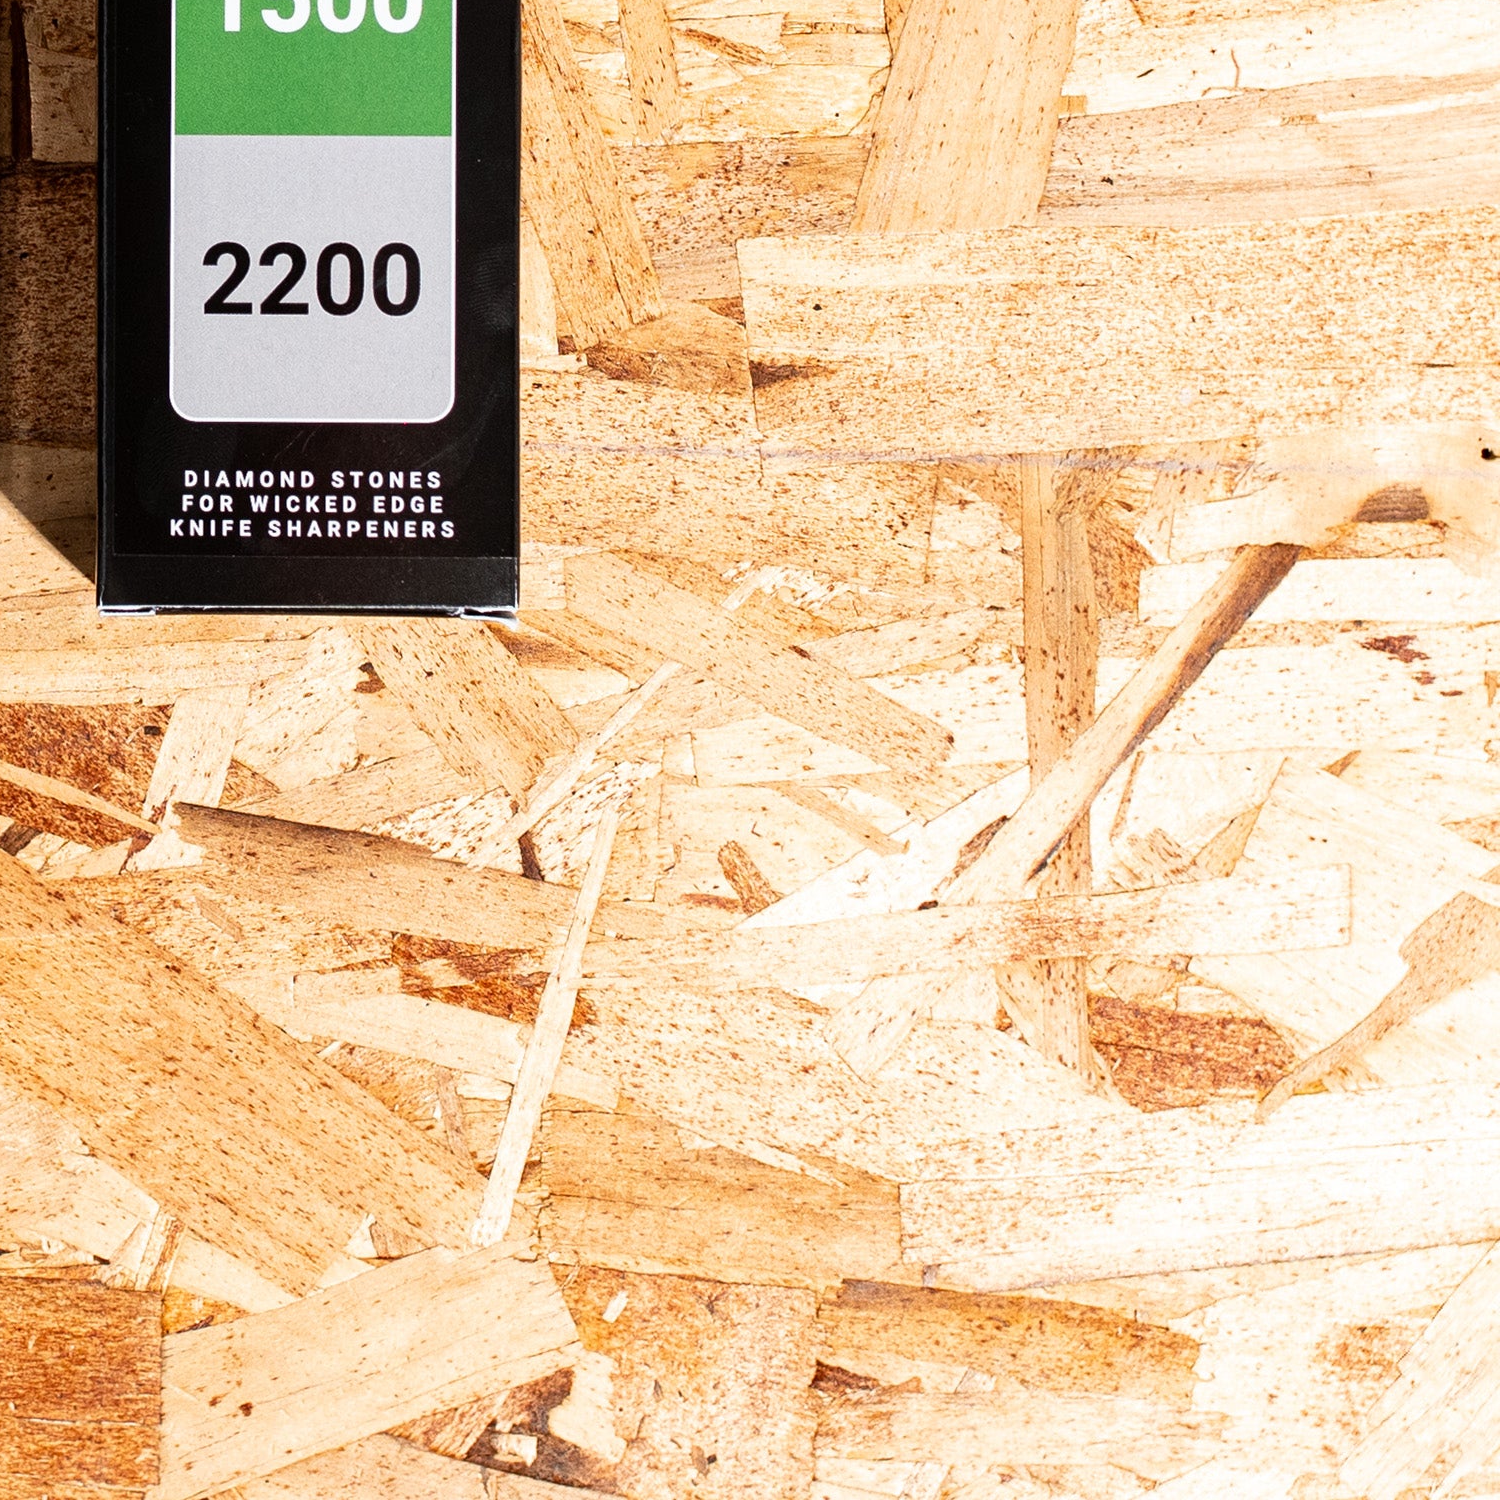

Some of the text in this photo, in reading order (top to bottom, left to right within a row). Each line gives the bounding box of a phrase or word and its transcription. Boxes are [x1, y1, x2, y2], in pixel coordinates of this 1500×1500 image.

[202, 241, 421, 317] 2200
[184, 469, 442, 490] DIAMOND STONES
[181, 494, 445, 514] FOR WICKED EDGE
[170, 518, 456, 539] KNIFE SHARPENERS
